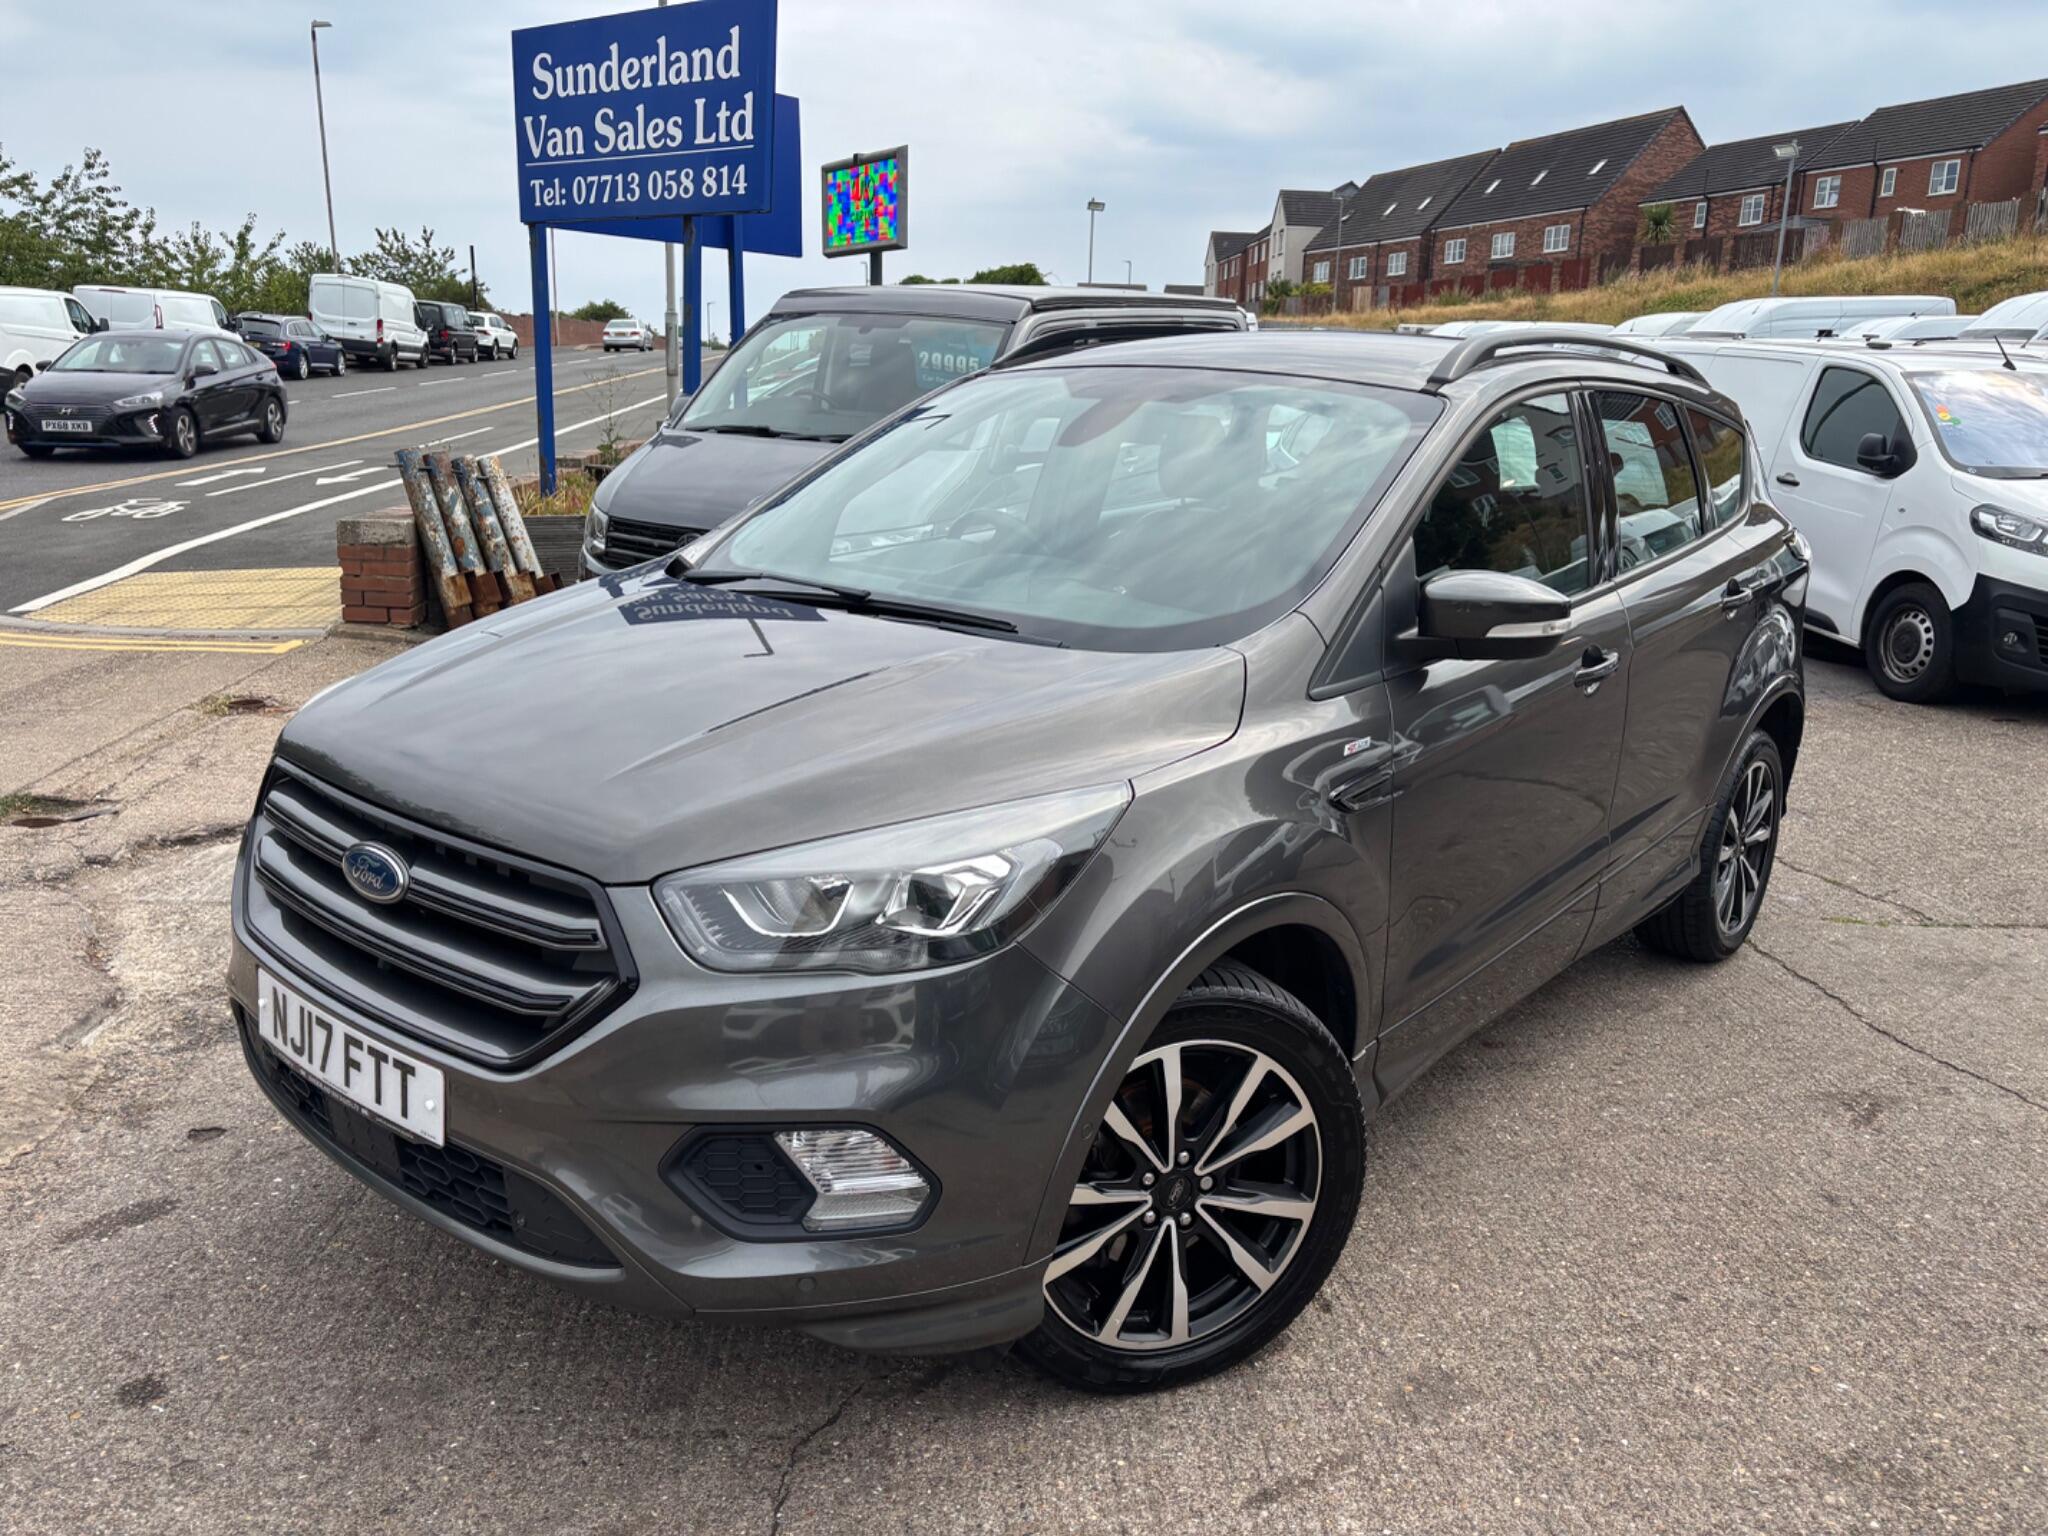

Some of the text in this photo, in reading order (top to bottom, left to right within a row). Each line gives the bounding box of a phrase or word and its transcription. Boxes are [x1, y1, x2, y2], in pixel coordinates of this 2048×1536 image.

[532, 25, 741, 100] Sunderland
[523, 91, 754, 159] Van Sales Ltd
[530, 164, 748, 207] Tel: 07713 058 814
[919, 351, 980, 374] 29995
[352, 855, 388, 890] Ford
[272, 986, 333, 1074] NJ17
[343, 1032, 416, 1121] FTT
